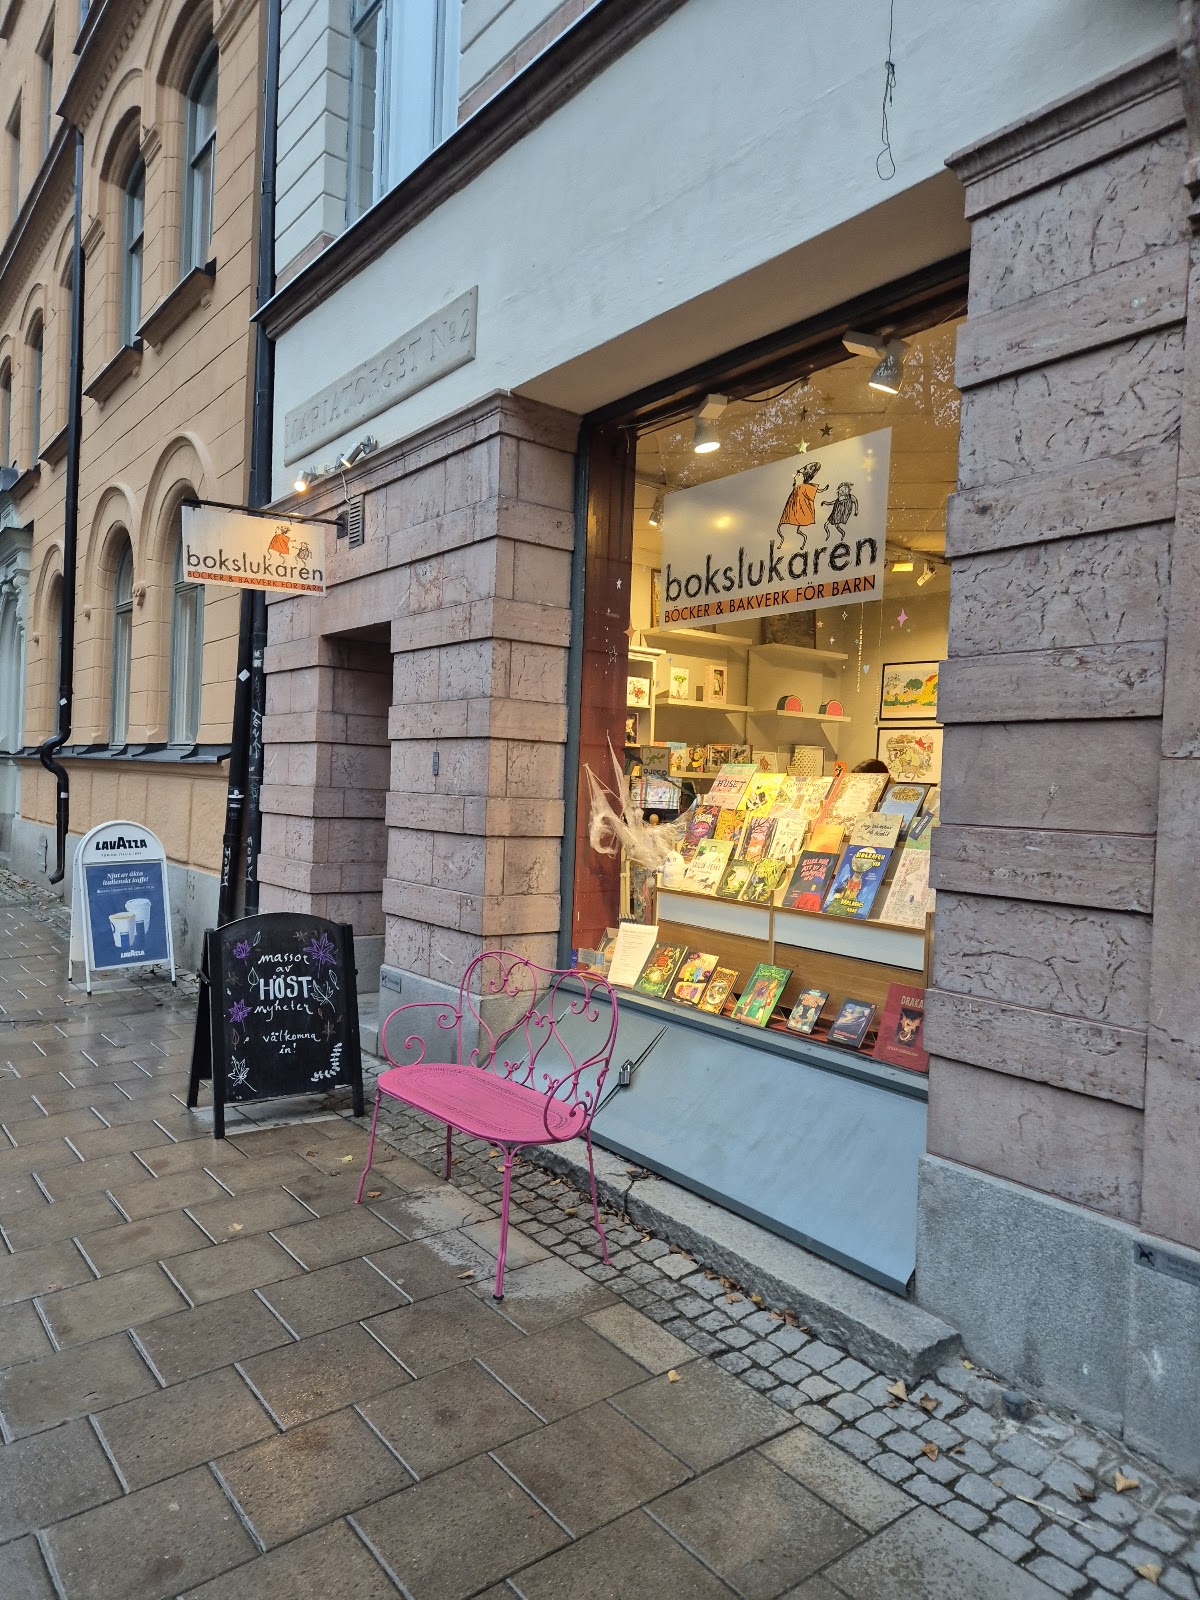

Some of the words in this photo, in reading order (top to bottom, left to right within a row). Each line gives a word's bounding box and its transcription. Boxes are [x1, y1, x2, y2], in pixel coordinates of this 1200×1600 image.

[186, 545, 324, 581] bokslukaren
[666, 538, 878, 602] bokslukaren
[187, 570, 225, 581] BÖCKER
[228, 575, 236, 584] &
[238, 576, 279, 588] BAKVERK
[281, 580, 299, 590] FÖR
[301, 583, 324, 593] BARN
[664, 604, 711, 623] BÖCKER
[715, 604, 724, 615] &
[729, 590, 790, 613] BAKVERK
[796, 582, 825, 600] FÖR
[831, 576, 876, 596] BARN
[95, 836, 148, 851] LAVAZZA
[258, 953, 310, 965] massor
[275, 964, 294, 973] av
[900, 995, 923, 1009] DRAKA
[253, 1000, 315, 1022] nyheter
[262, 1029, 322, 1043] välkomna
[278, 1043, 297, 1054] in!
